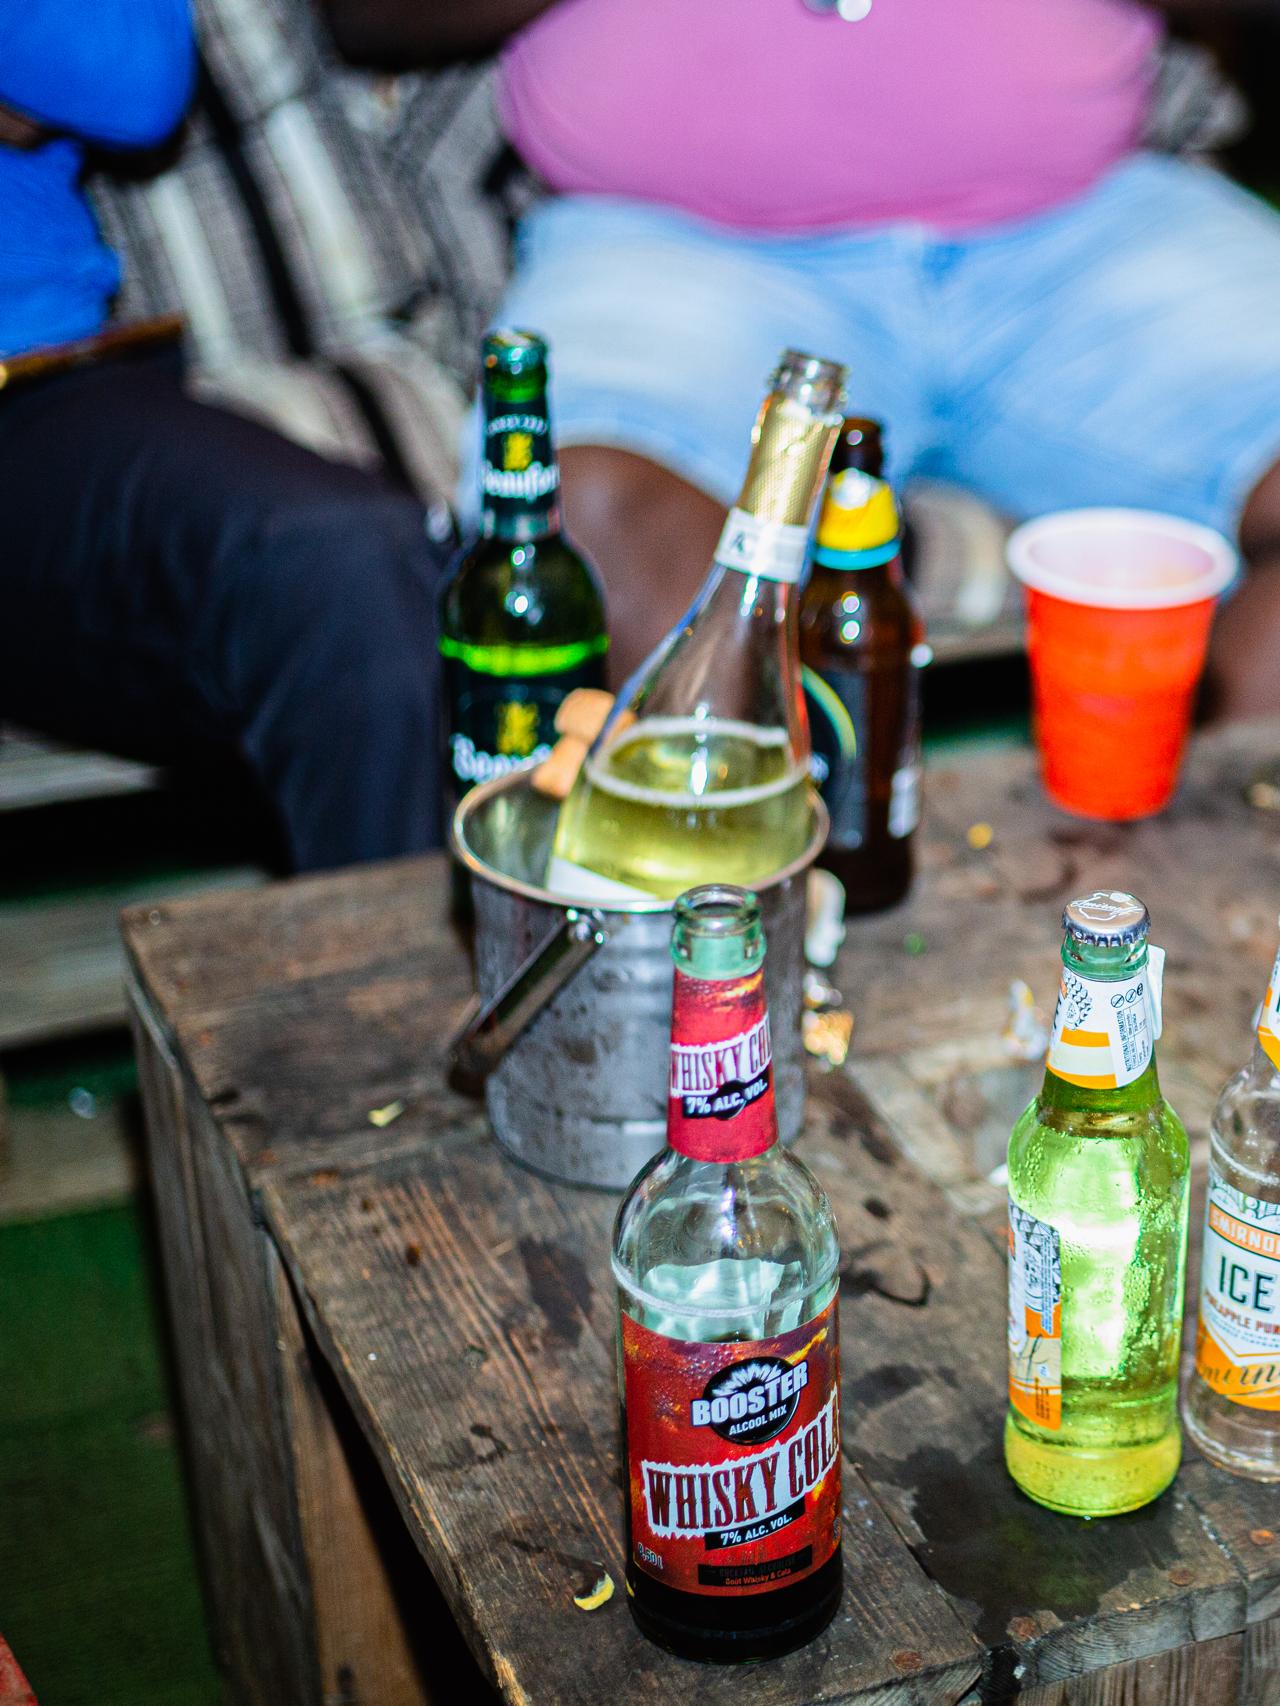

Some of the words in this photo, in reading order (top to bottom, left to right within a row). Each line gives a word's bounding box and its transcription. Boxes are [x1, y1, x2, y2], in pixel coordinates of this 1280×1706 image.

[685, 1096, 711, 1115] 7%
[713, 1092, 744, 1111] ALC.
[1219, 1256, 1273, 1311] ICE
[692, 1360, 808, 1427] BOOSTER
[729, 1415, 768, 1436] ALCOOL
[769, 1404, 788, 1421] MIX
[646, 1451, 780, 1529] WHISKY
[788, 1392, 839, 1498] COLA
[720, 1530, 742, 1546] 7%
[745, 1526, 768, 1541] ALC.
[771, 1514, 792, 1530] VOL.
